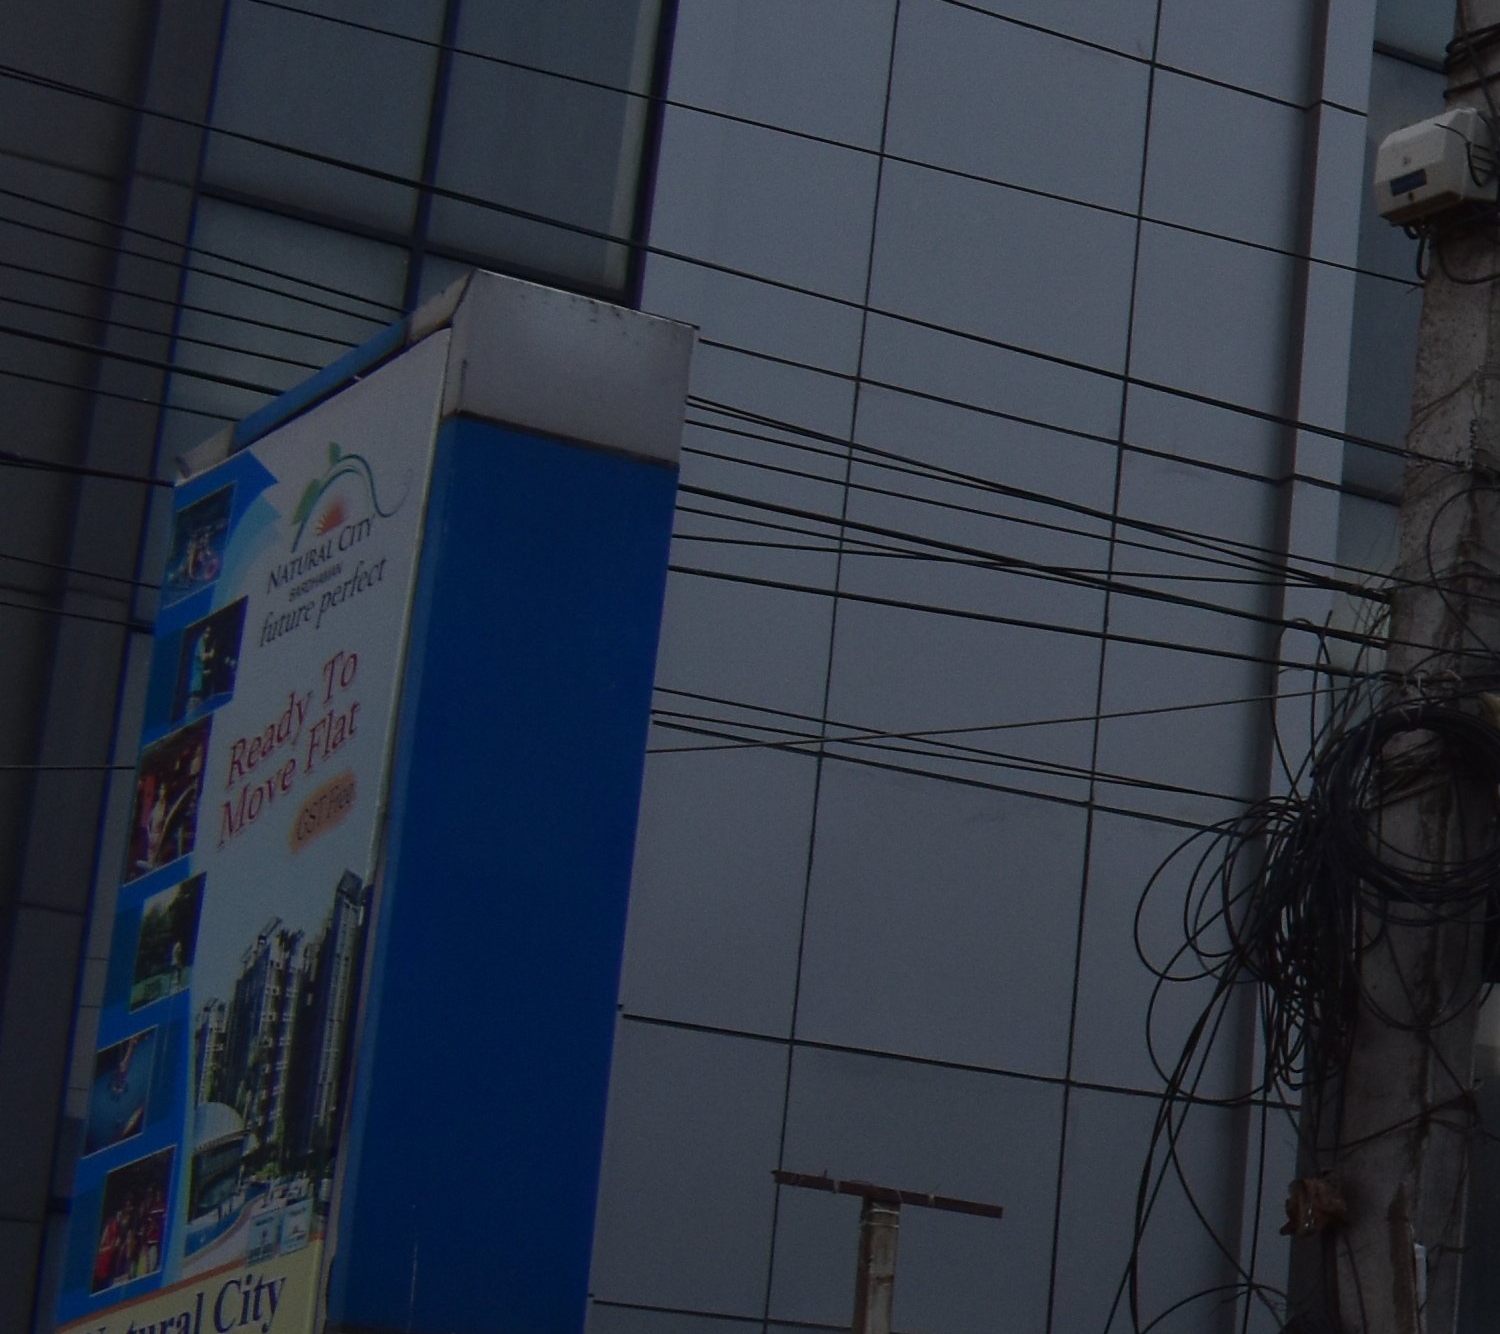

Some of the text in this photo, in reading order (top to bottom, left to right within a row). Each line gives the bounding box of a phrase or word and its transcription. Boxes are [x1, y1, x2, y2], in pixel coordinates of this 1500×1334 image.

[267, 516, 374, 594] NATURAL CITY
[260, 558, 386, 647] future perfect
[226, 651, 357, 788] Ready To
[217, 701, 360, 849] Move Flat
[214, 1274, 286, 1334] City
